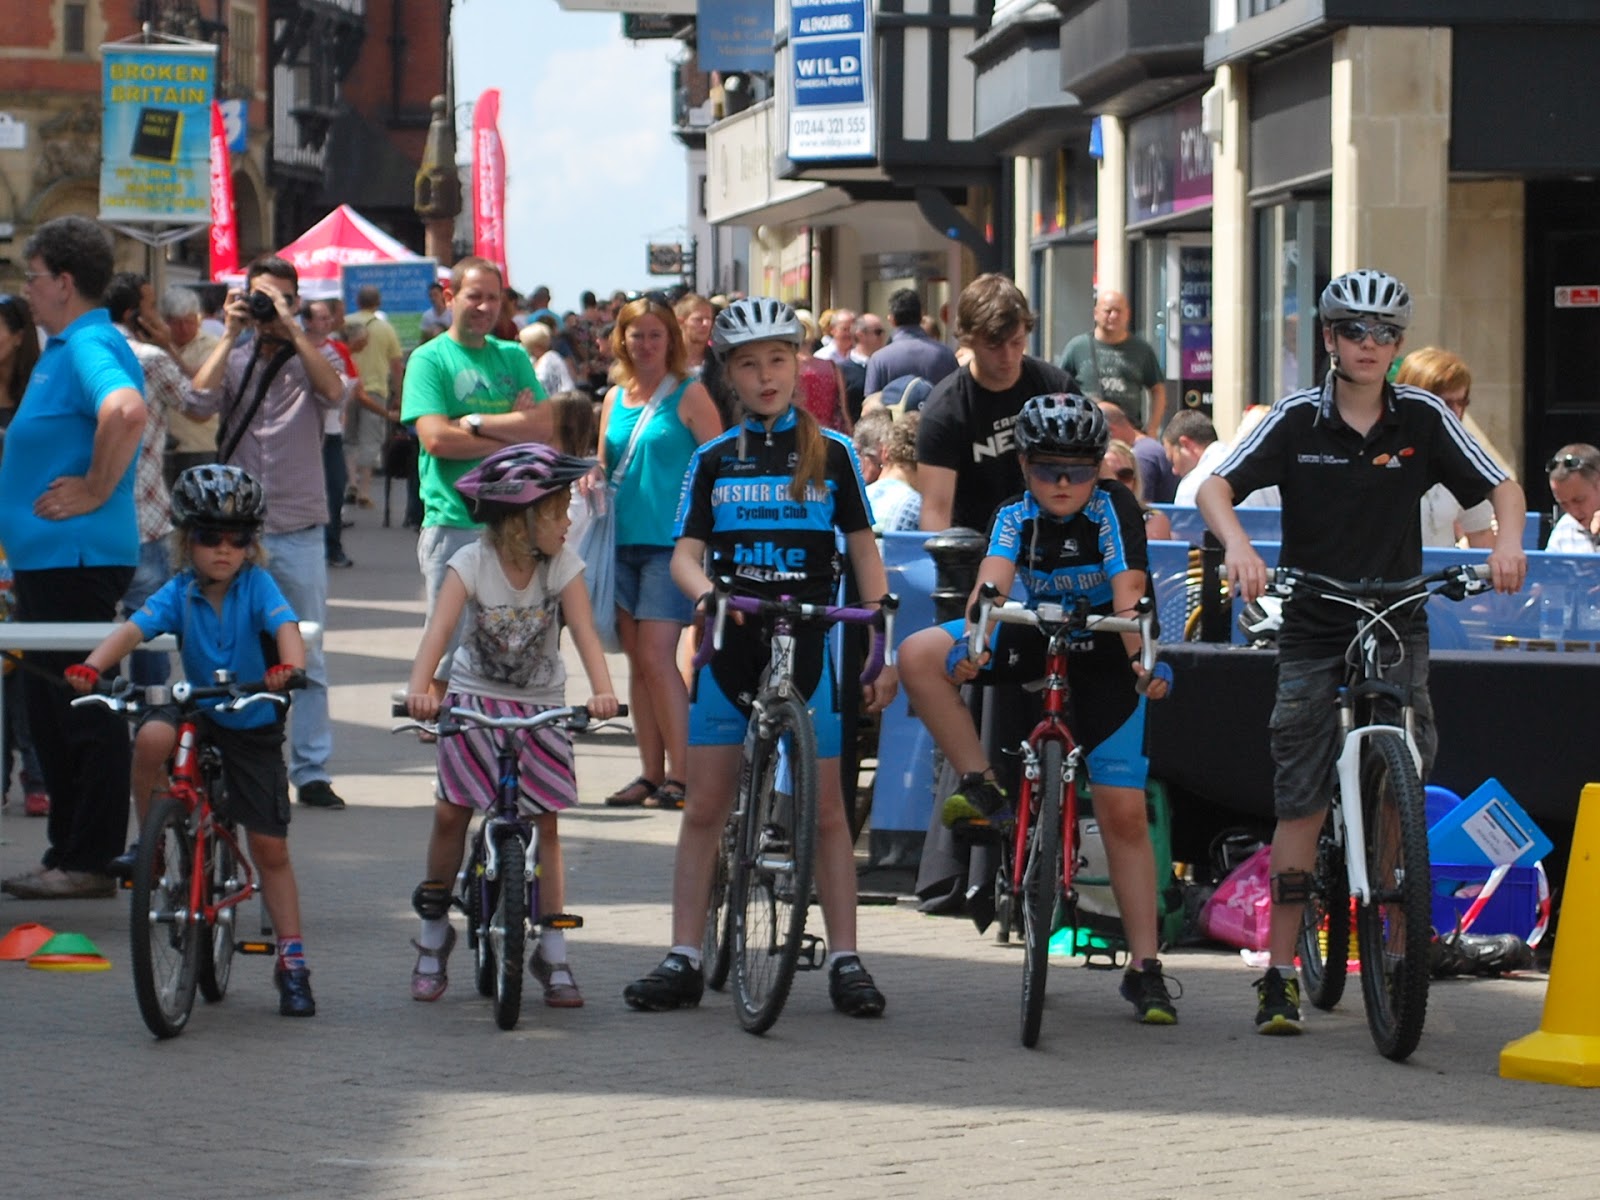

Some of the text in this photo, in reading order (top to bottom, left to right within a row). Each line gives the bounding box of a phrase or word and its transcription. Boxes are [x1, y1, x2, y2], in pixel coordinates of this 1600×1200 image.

[110, 63, 208, 82] BROKEN
[797, 56, 859, 77] WILD
[111, 85, 206, 104] BRITAIN
[794, 116, 866, 136] 01244 321 555
[973, 429, 1015, 463] NE
[711, 484, 770, 507] CHESTER
[737, 505, 808, 520] Cycling Club
[733, 541, 807, 573] bike
